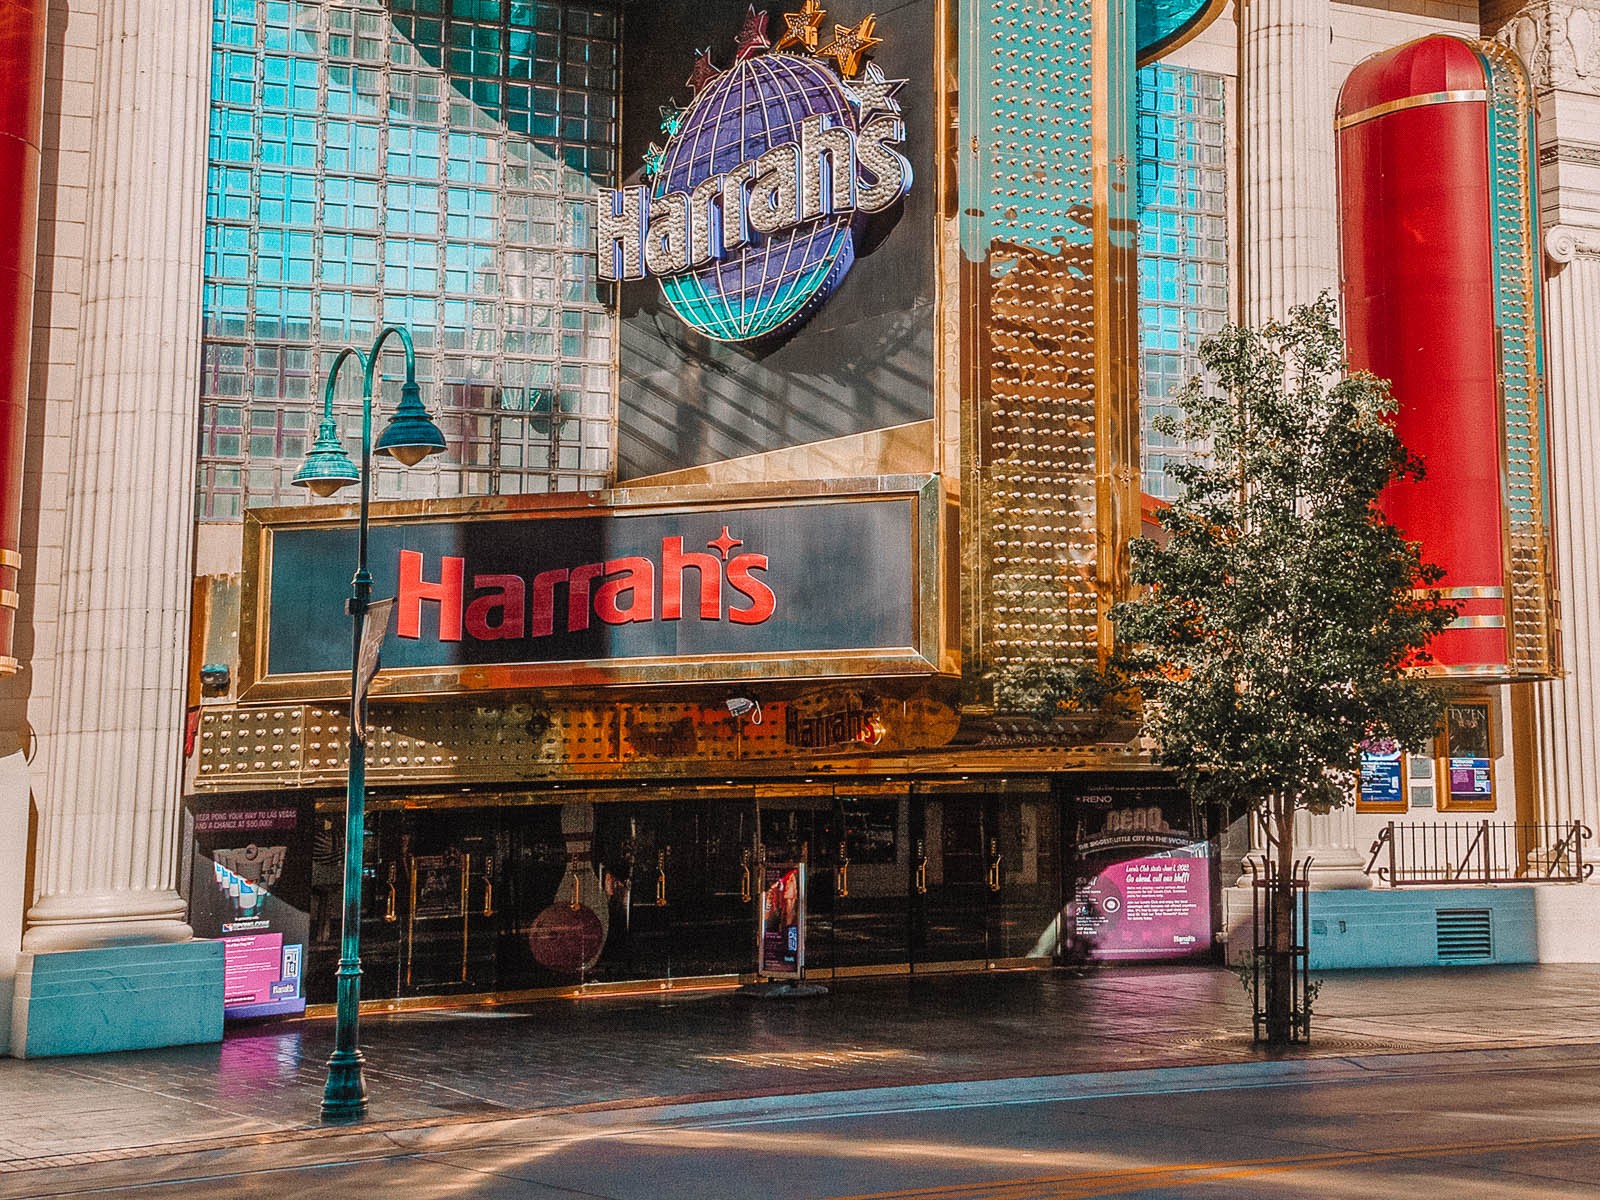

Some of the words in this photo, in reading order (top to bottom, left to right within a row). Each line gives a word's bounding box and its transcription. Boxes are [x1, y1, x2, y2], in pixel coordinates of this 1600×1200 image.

[396, 525, 777, 642] Harrah's
[1082, 795, 1113, 803] RENO
[211, 813, 227, 821] PONG
[228, 812, 244, 820] YOUR
[258, 811, 266, 819] TO
[266, 811, 277, 819] LAS
[278, 810, 297, 818] VEGAS
[195, 822, 208, 830] AND
[213, 821, 237, 829] CHANCE
[1089, 838, 1112, 847] BIGGEST
[1113, 835, 1131, 843] LITTLE
[1168, 837, 1195, 846] WORLD
[1140, 864, 1150, 872] Club
[1126, 873, 1135, 883] Go
[1152, 873, 1163, 883] call
